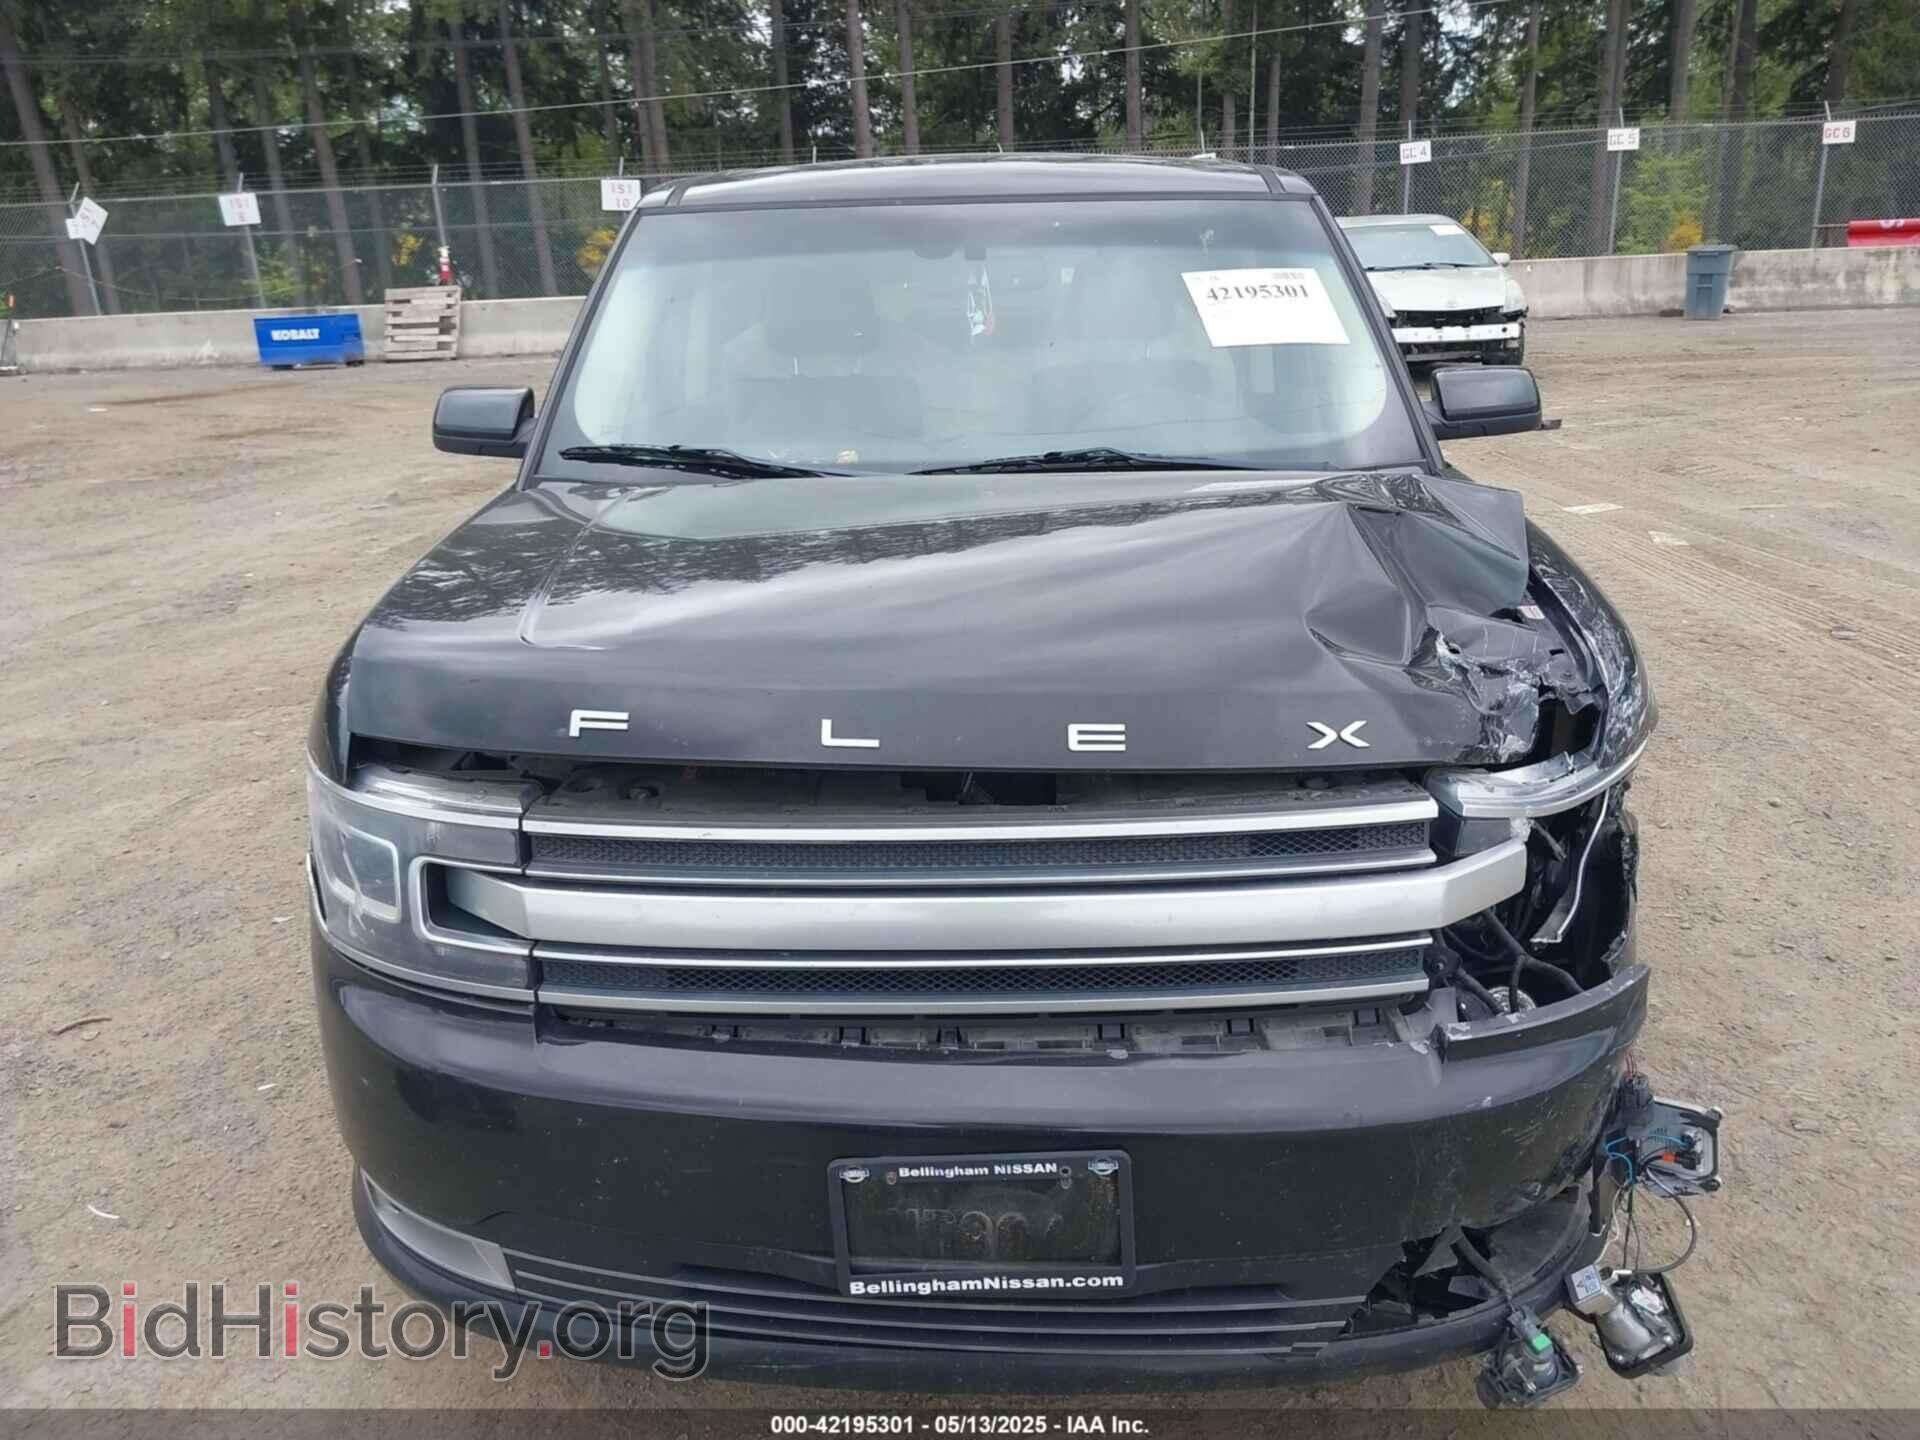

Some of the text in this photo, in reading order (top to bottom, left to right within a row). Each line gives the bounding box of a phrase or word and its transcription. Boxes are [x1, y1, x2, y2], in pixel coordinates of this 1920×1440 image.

[1206, 283, 1310, 301] 42195301
[271, 327, 320, 341] KOBALT
[568, 708, 1371, 753] FLEX
[898, 1162, 1058, 1179] Bellingham NISSAN
[849, 1275, 1124, 1295] BellinghamNissan.com
